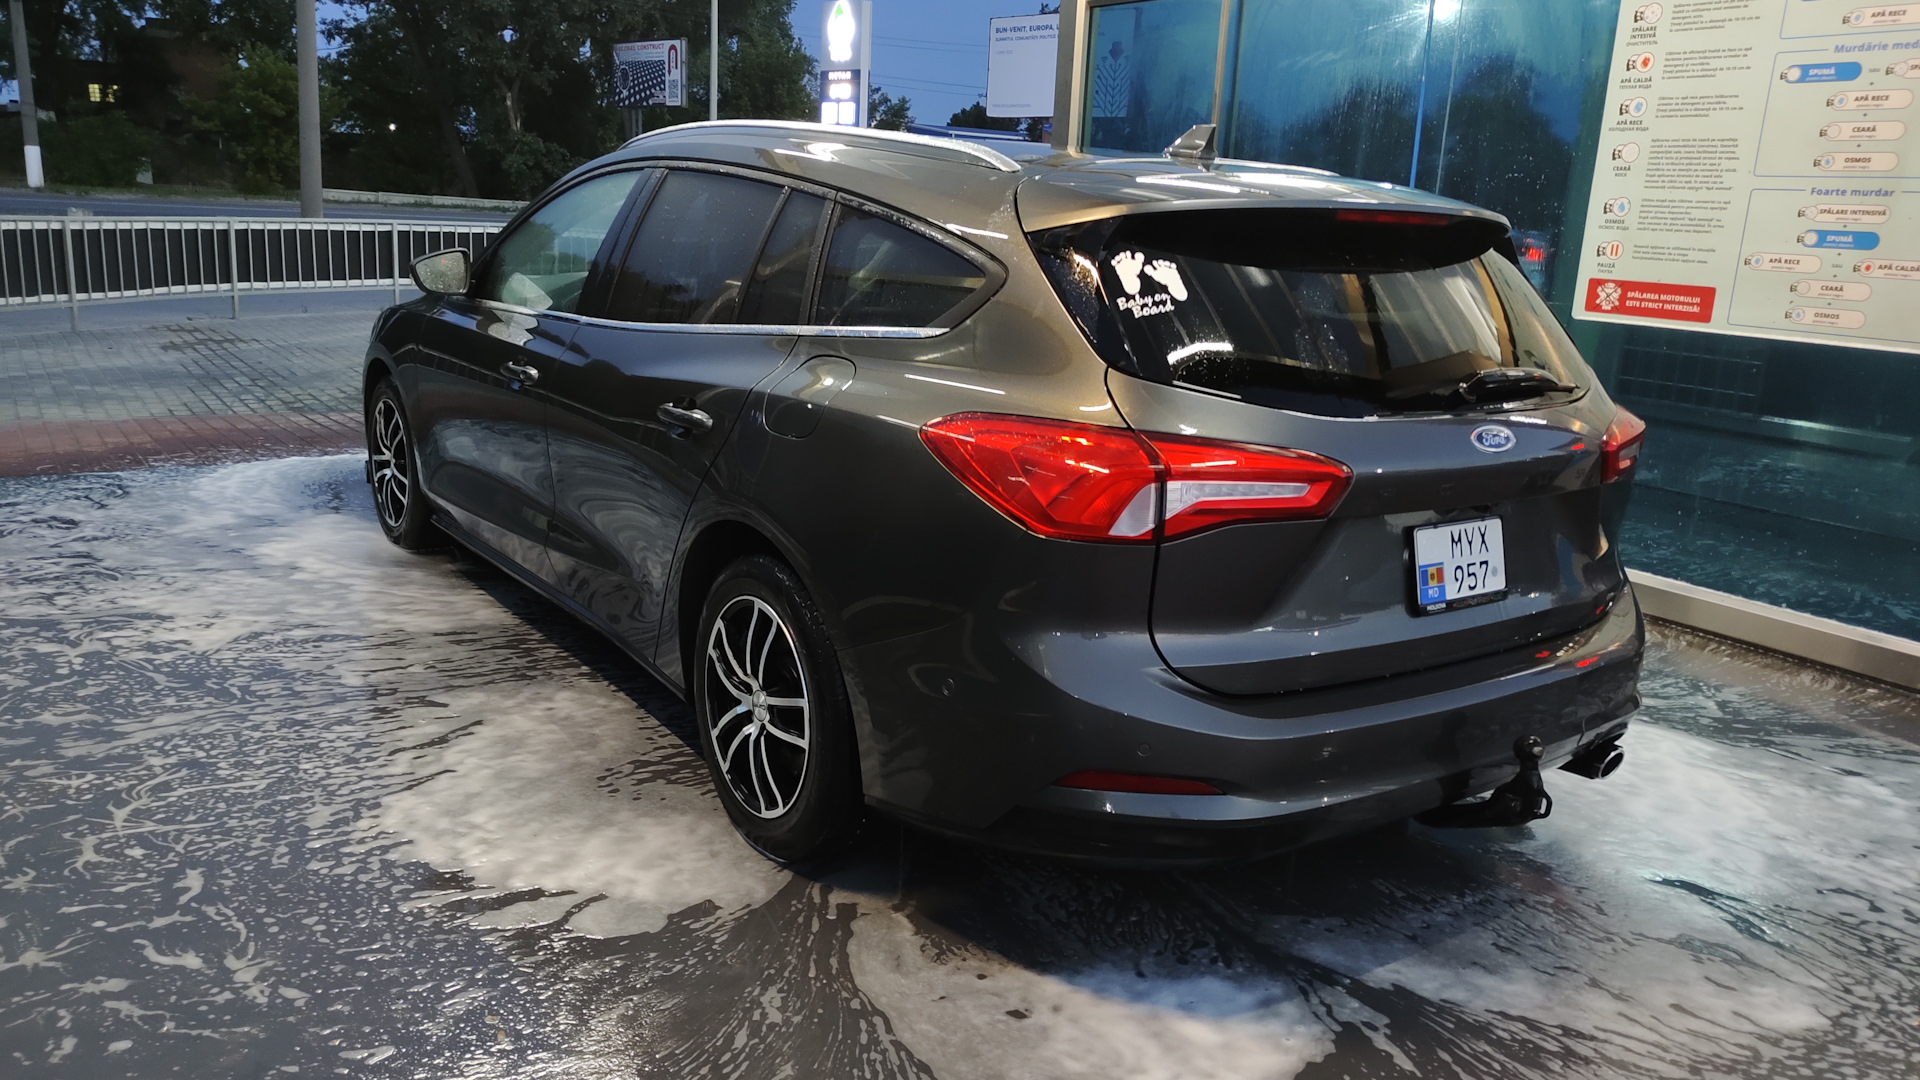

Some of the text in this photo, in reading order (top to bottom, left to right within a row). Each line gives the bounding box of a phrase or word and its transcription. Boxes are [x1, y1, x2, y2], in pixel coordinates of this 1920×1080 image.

[1871, 9, 1907, 18] APĂ RECE
[1834, 42, 1889, 53] Murdărie
[1808, 67, 1836, 76] SPUMĂ
[1854, 94, 1869, 102] APĂ
[1810, 187, 1895, 197] Foarte murdar
[1117, 293, 1171, 311] Baby on
[1627, 291, 1701, 303] SPĂLAREA MOTORULUI
[1132, 300, 1175, 319] Board
[1641, 301, 1663, 309] STRICT
[1664, 303, 1700, 313] INTERZISĂ!
[1814, 312, 1840, 320] OSMOS
[1482, 431, 1507, 446] Ford
[1450, 525, 1489, 559] MYX
[1454, 560, 1489, 594] 957
[1428, 588, 1439, 599] MD
[1426, 602, 1447, 611] MOLDOVA
